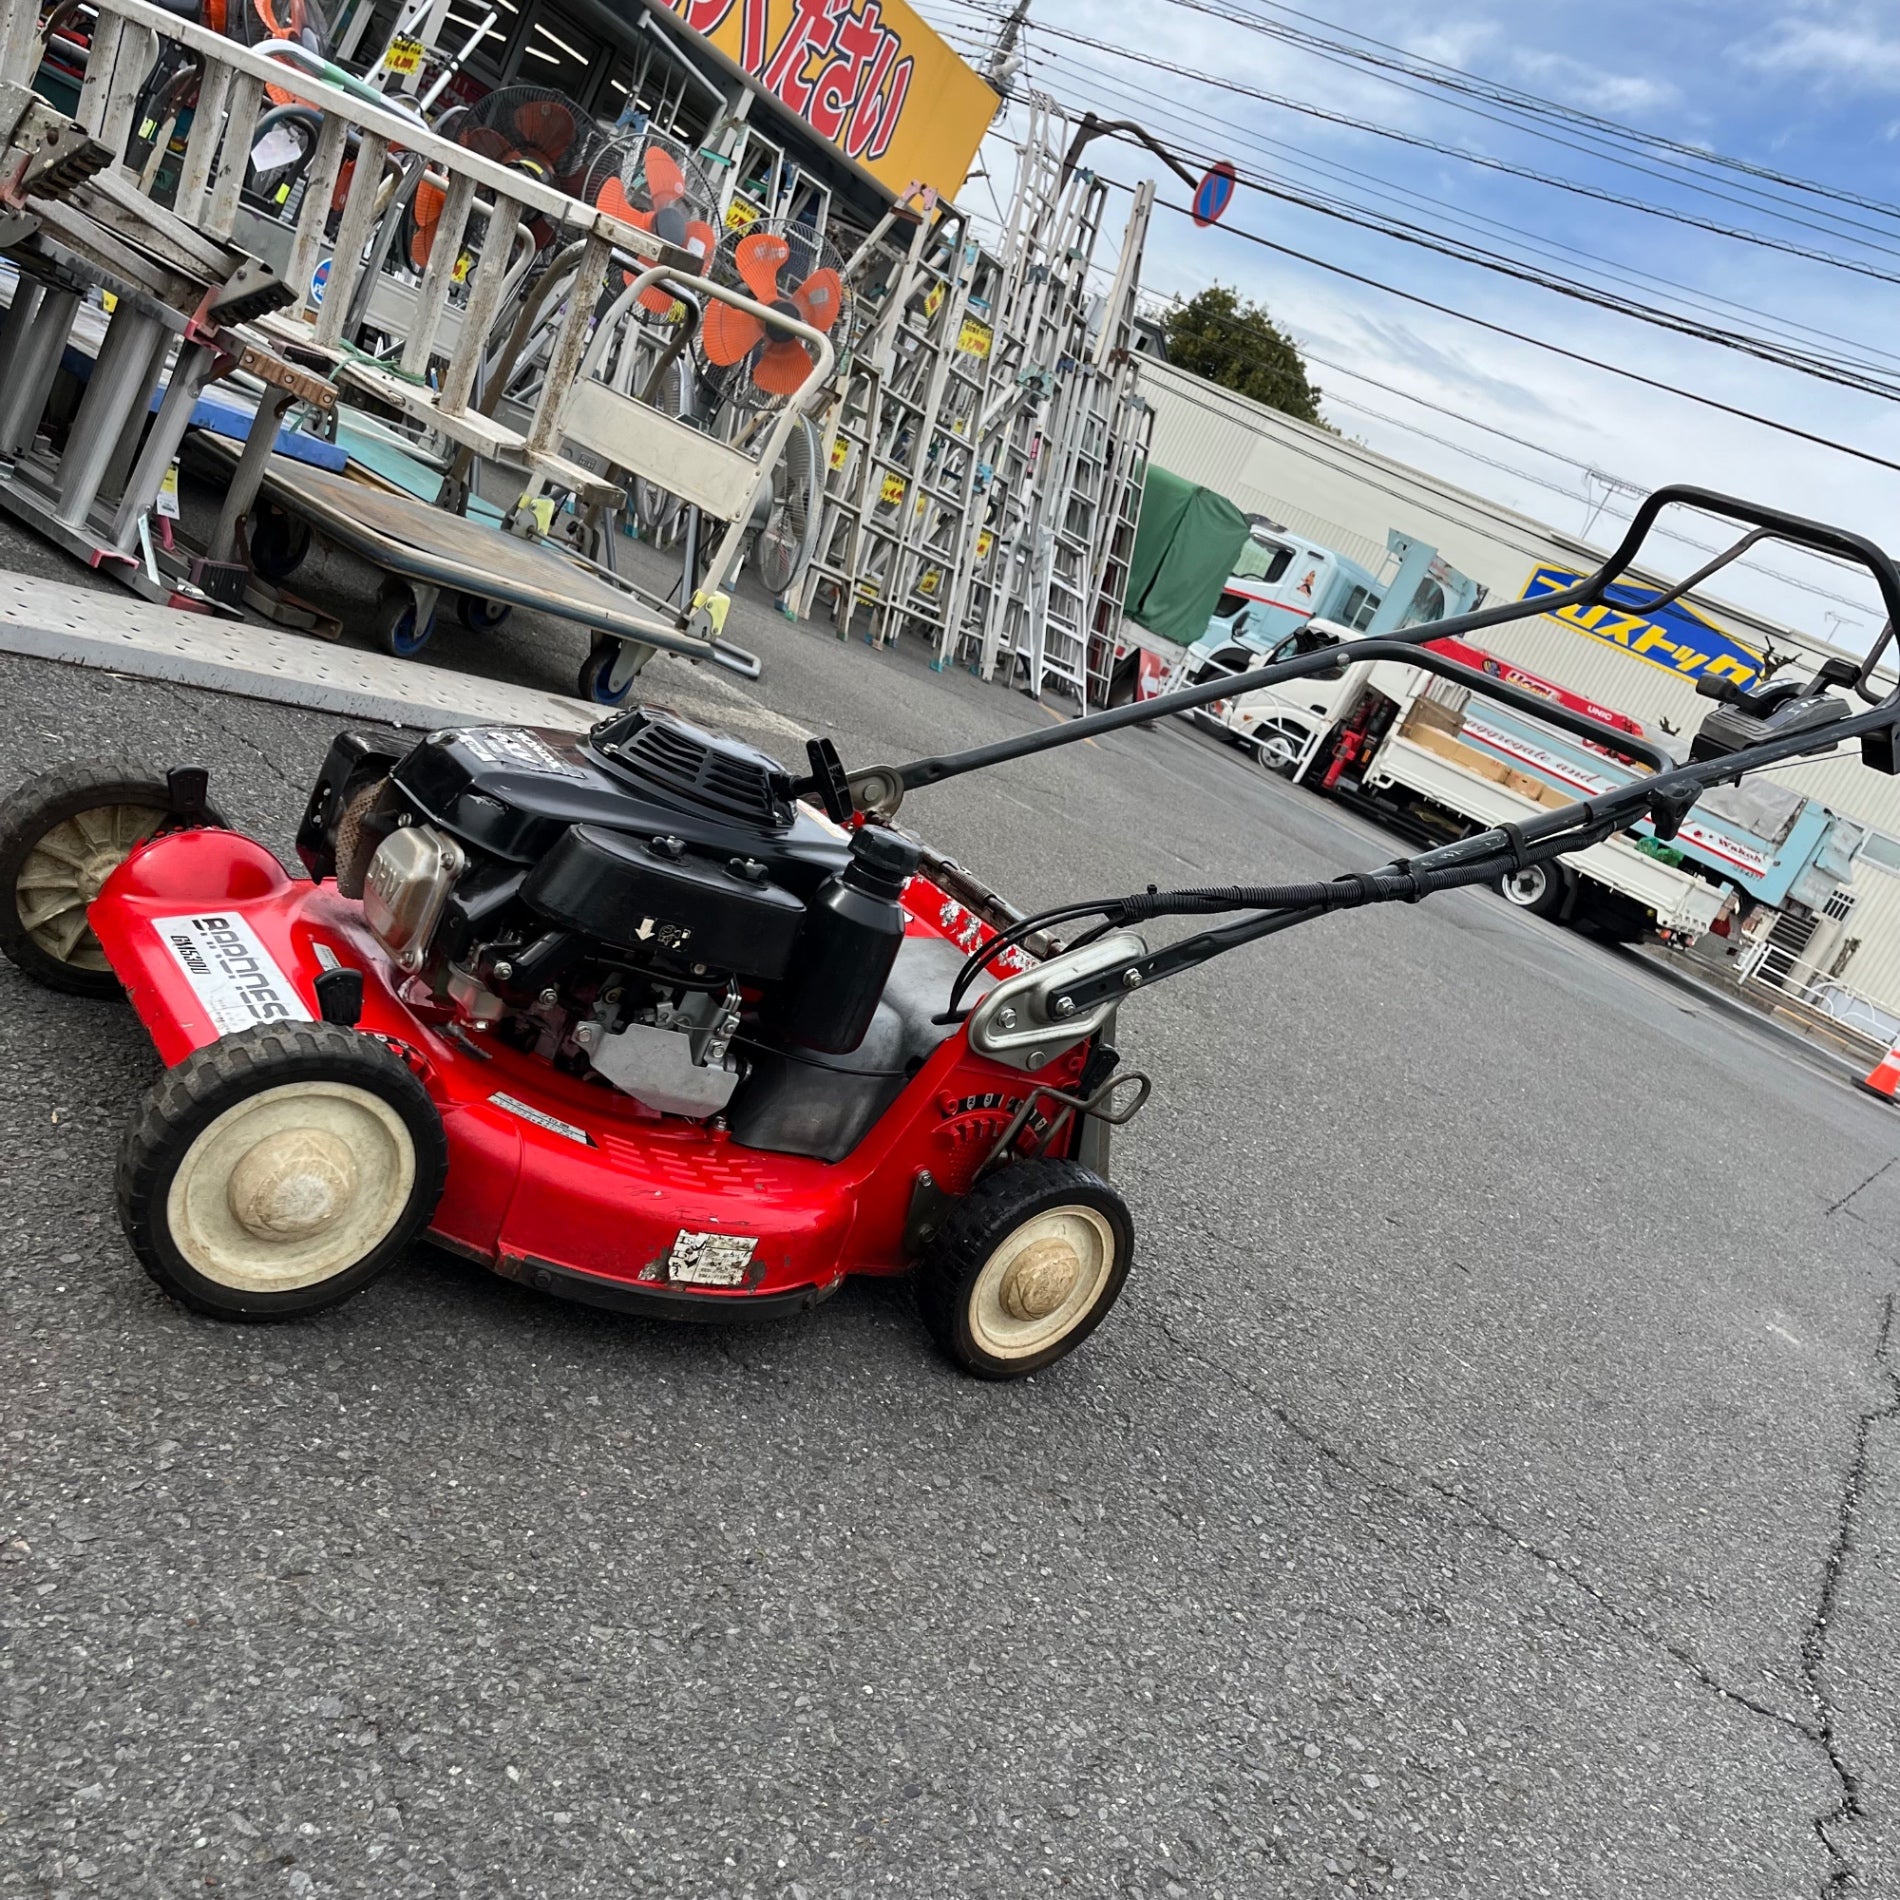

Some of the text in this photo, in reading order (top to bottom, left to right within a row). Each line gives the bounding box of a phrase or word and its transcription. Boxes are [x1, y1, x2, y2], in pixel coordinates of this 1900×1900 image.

[1587, 704, 1613, 721] UNIC
[1467, 720, 1600, 783] aggregate and
[191, 917, 290, 1024] BARONES
